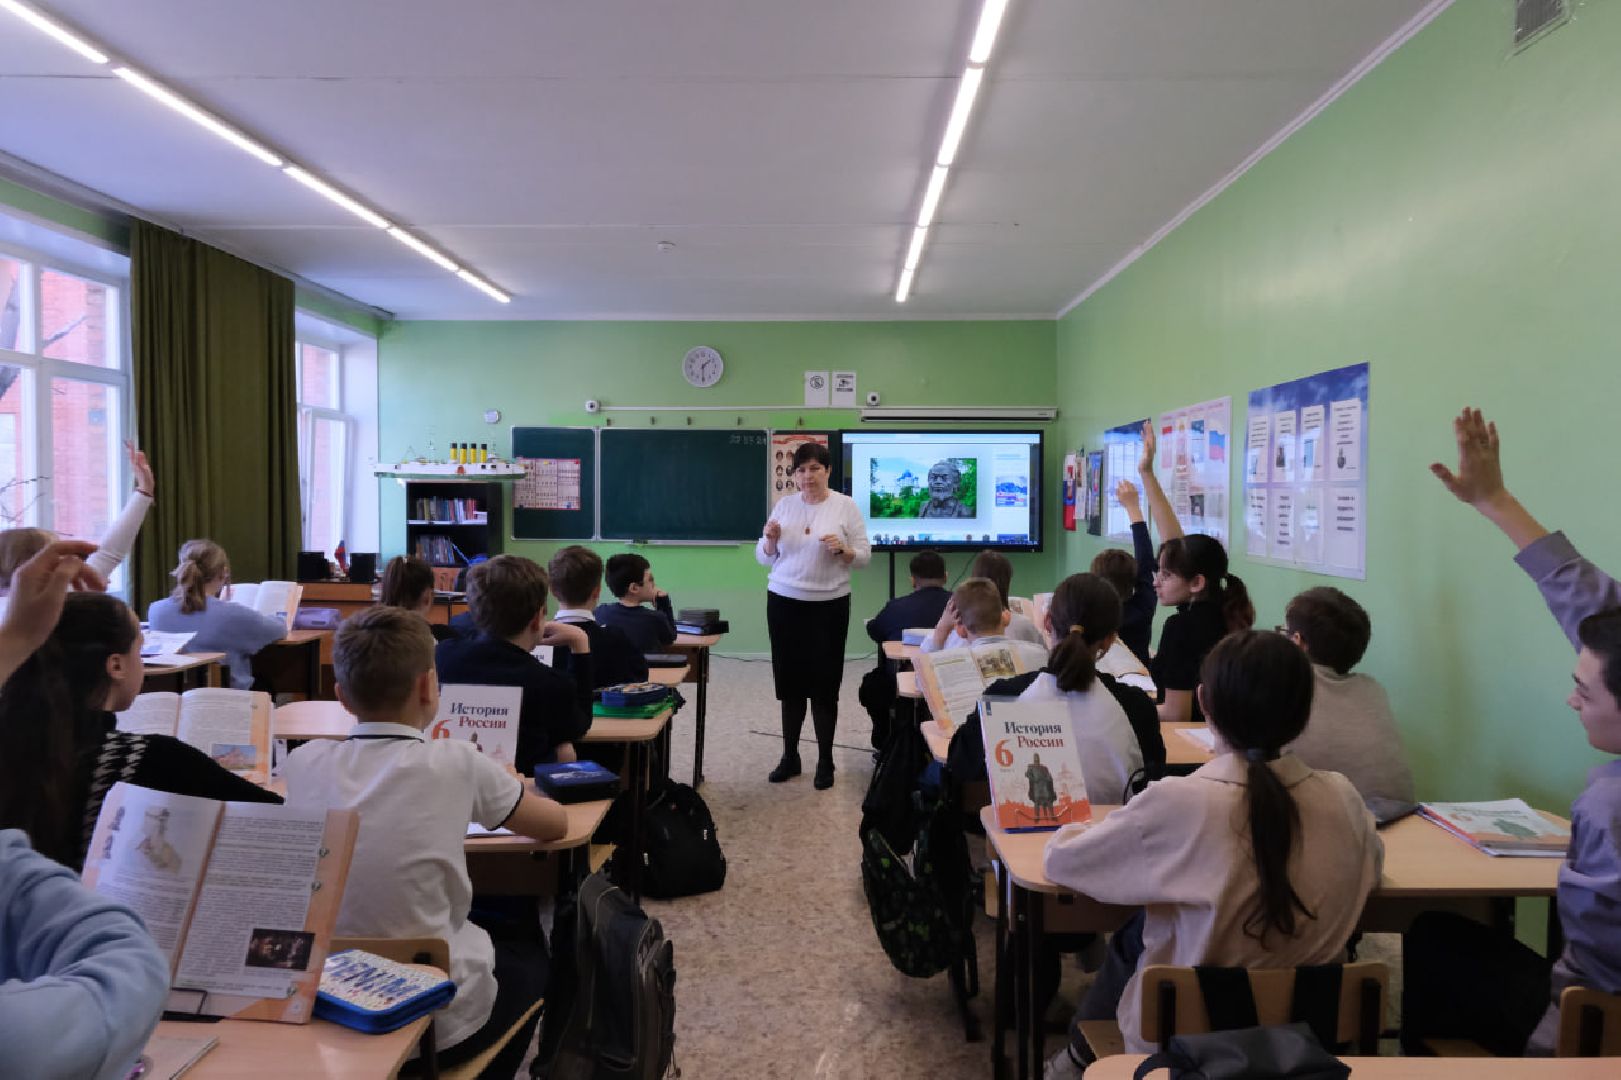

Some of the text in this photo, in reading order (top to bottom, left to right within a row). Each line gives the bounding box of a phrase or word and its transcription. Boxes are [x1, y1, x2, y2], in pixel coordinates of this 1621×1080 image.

[450, 702, 508, 717] История
[459, 715, 506, 729] России
[1004, 721, 1062, 736] История
[1018, 735, 1064, 748] России
[995, 739, 1014, 767] 6
